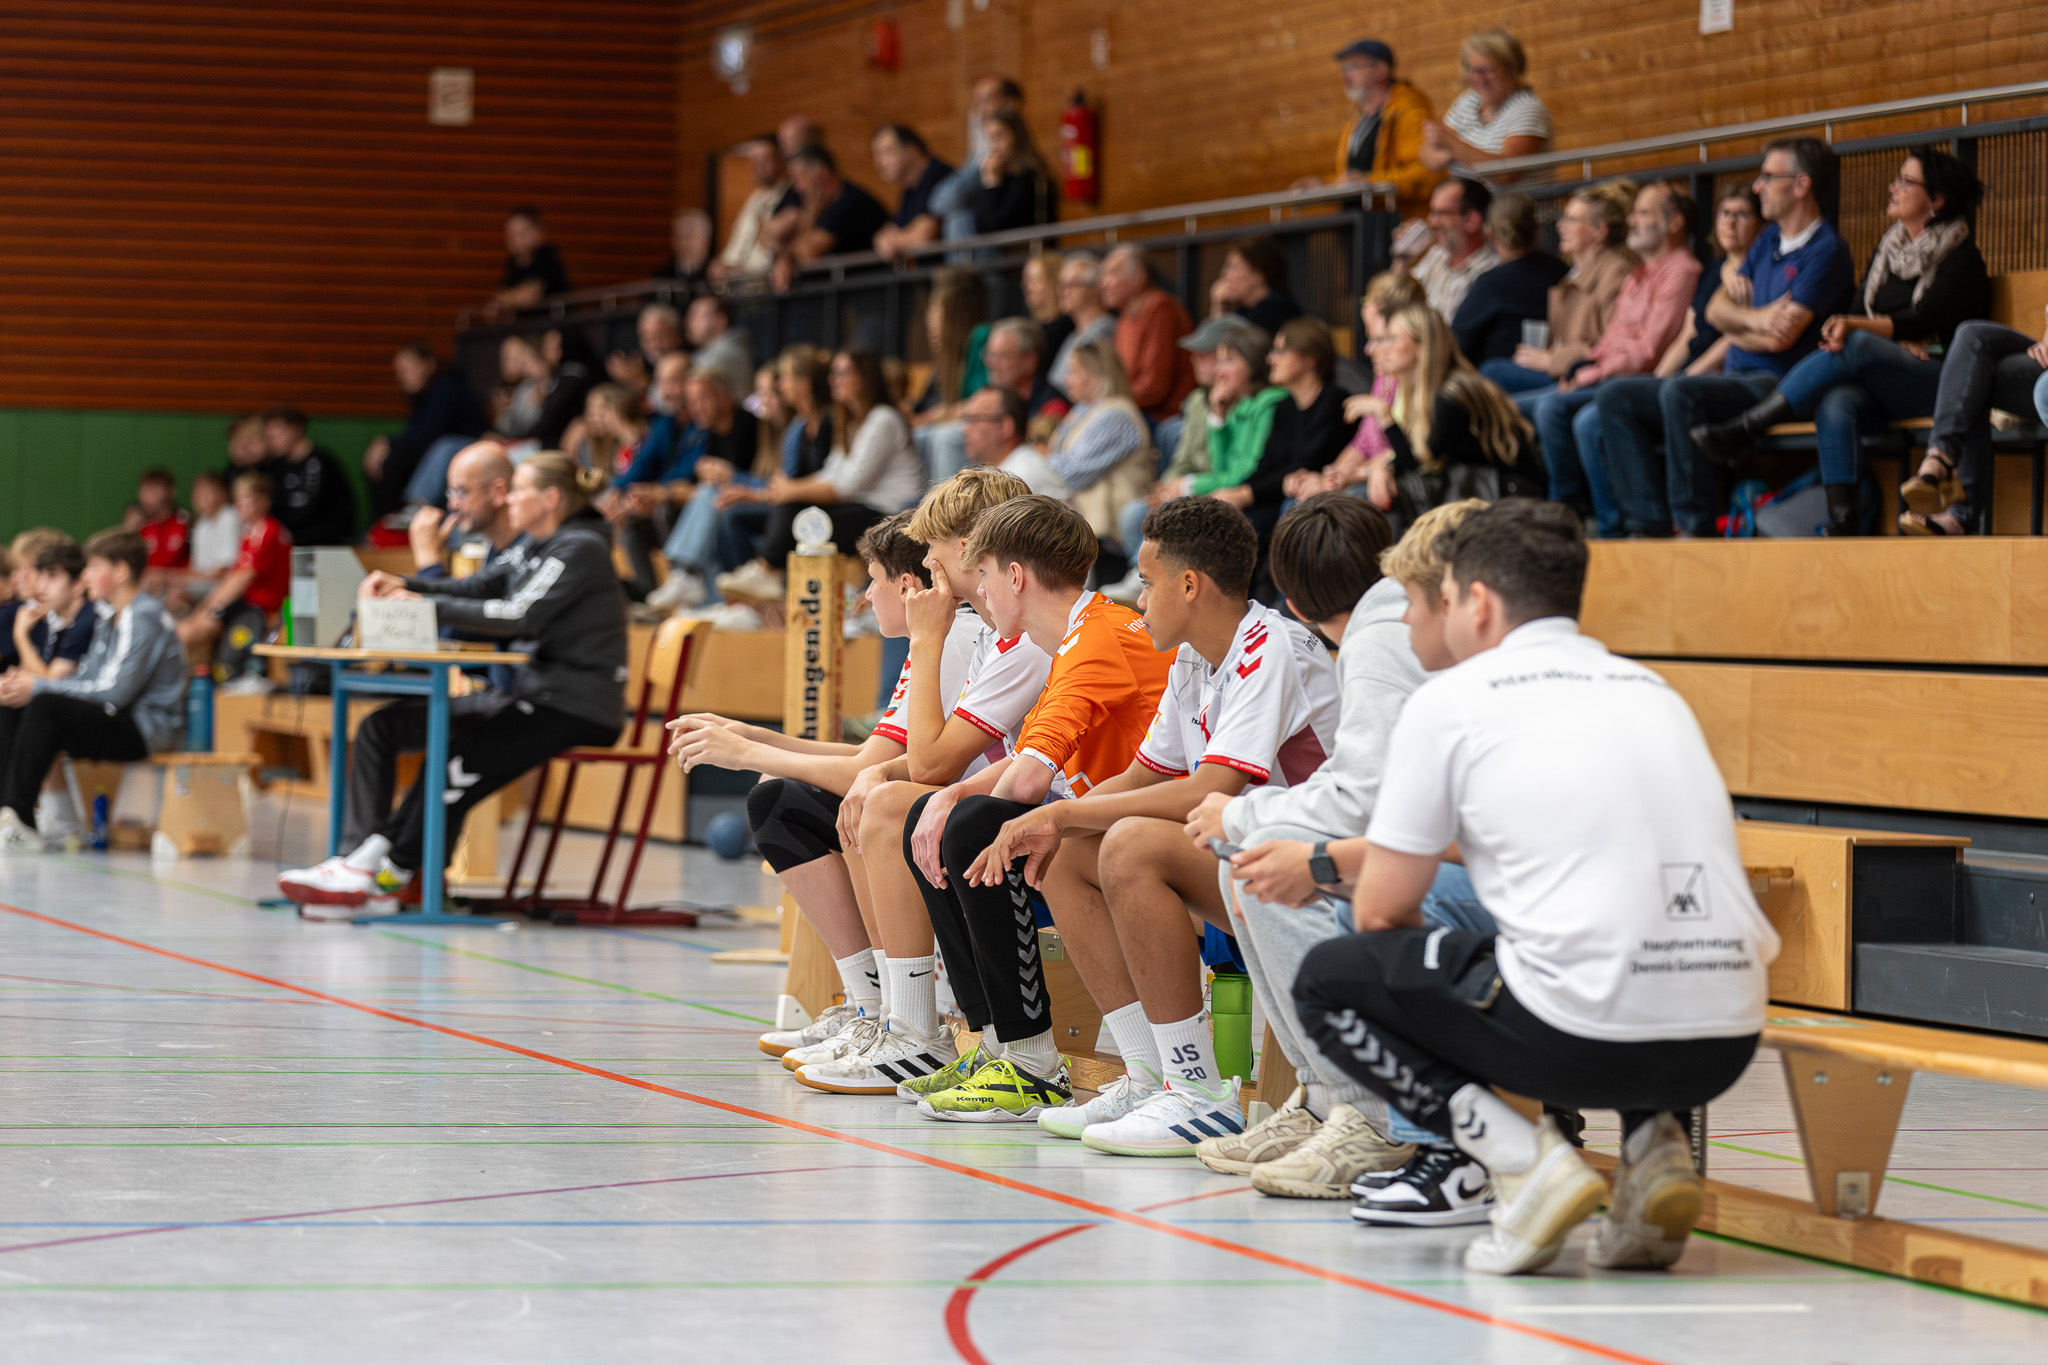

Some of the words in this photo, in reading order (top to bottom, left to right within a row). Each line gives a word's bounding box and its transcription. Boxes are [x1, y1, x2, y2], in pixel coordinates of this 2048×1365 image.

[1170, 1043, 1200, 1065] JS
[1181, 1066, 1207, 1081] 20
[956, 1096, 995, 1104] Kempa
